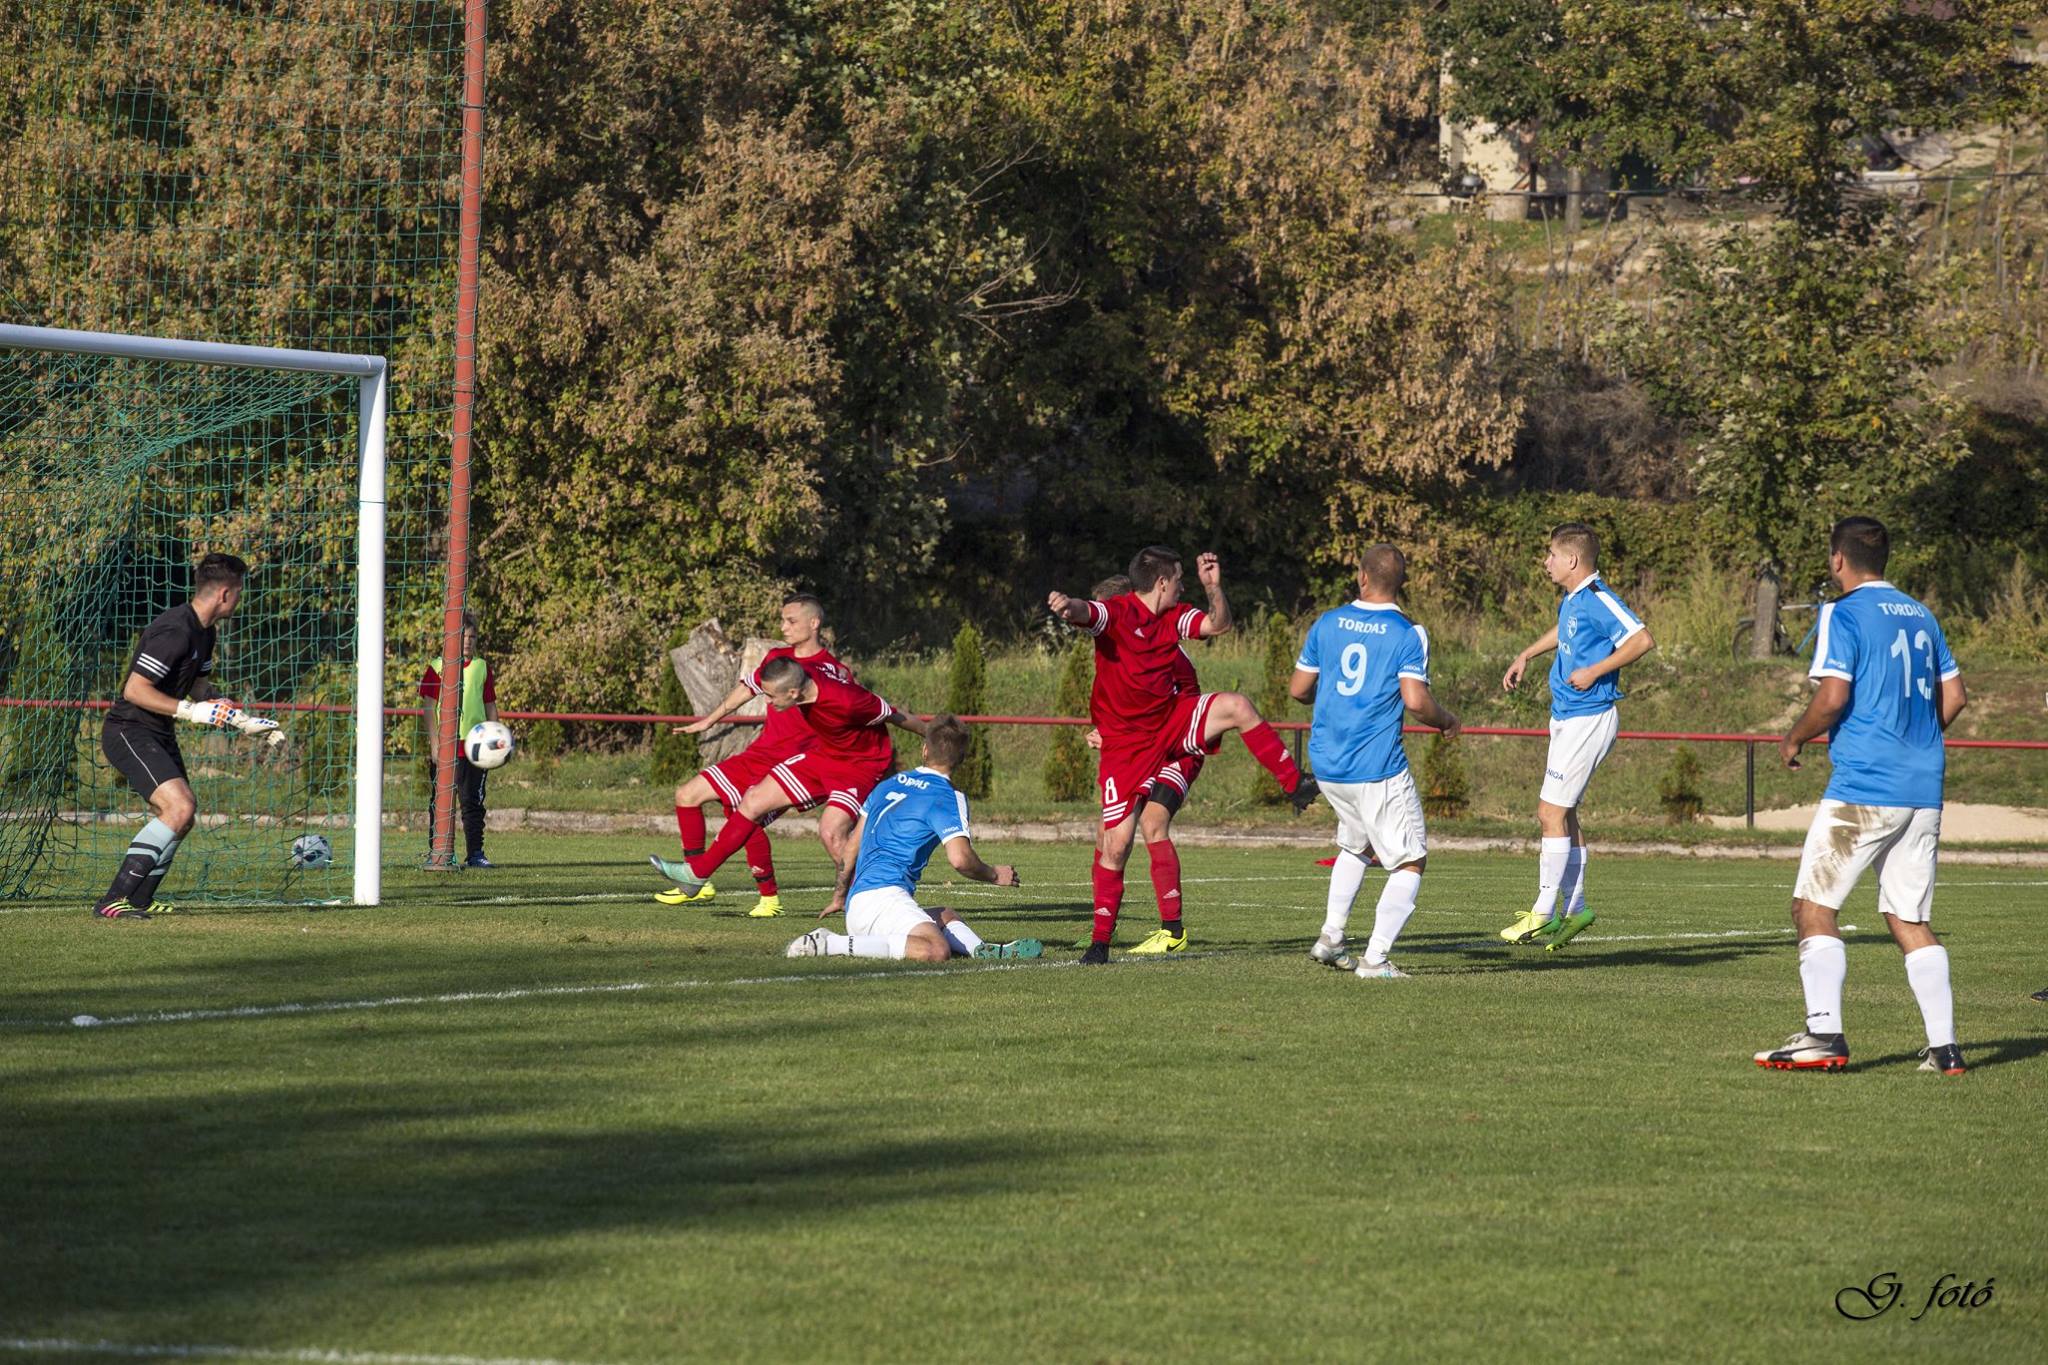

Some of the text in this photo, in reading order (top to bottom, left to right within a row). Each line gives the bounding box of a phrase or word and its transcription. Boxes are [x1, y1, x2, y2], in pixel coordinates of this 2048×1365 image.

[1338, 617, 1388, 634] TORDAS
[1336, 642, 1368, 697] 9
[1890, 629, 1934, 700] 13
[1105, 776, 1119, 805] 8
[1546, 768, 1564, 781] NIQA
[870, 791, 908, 834] 7
